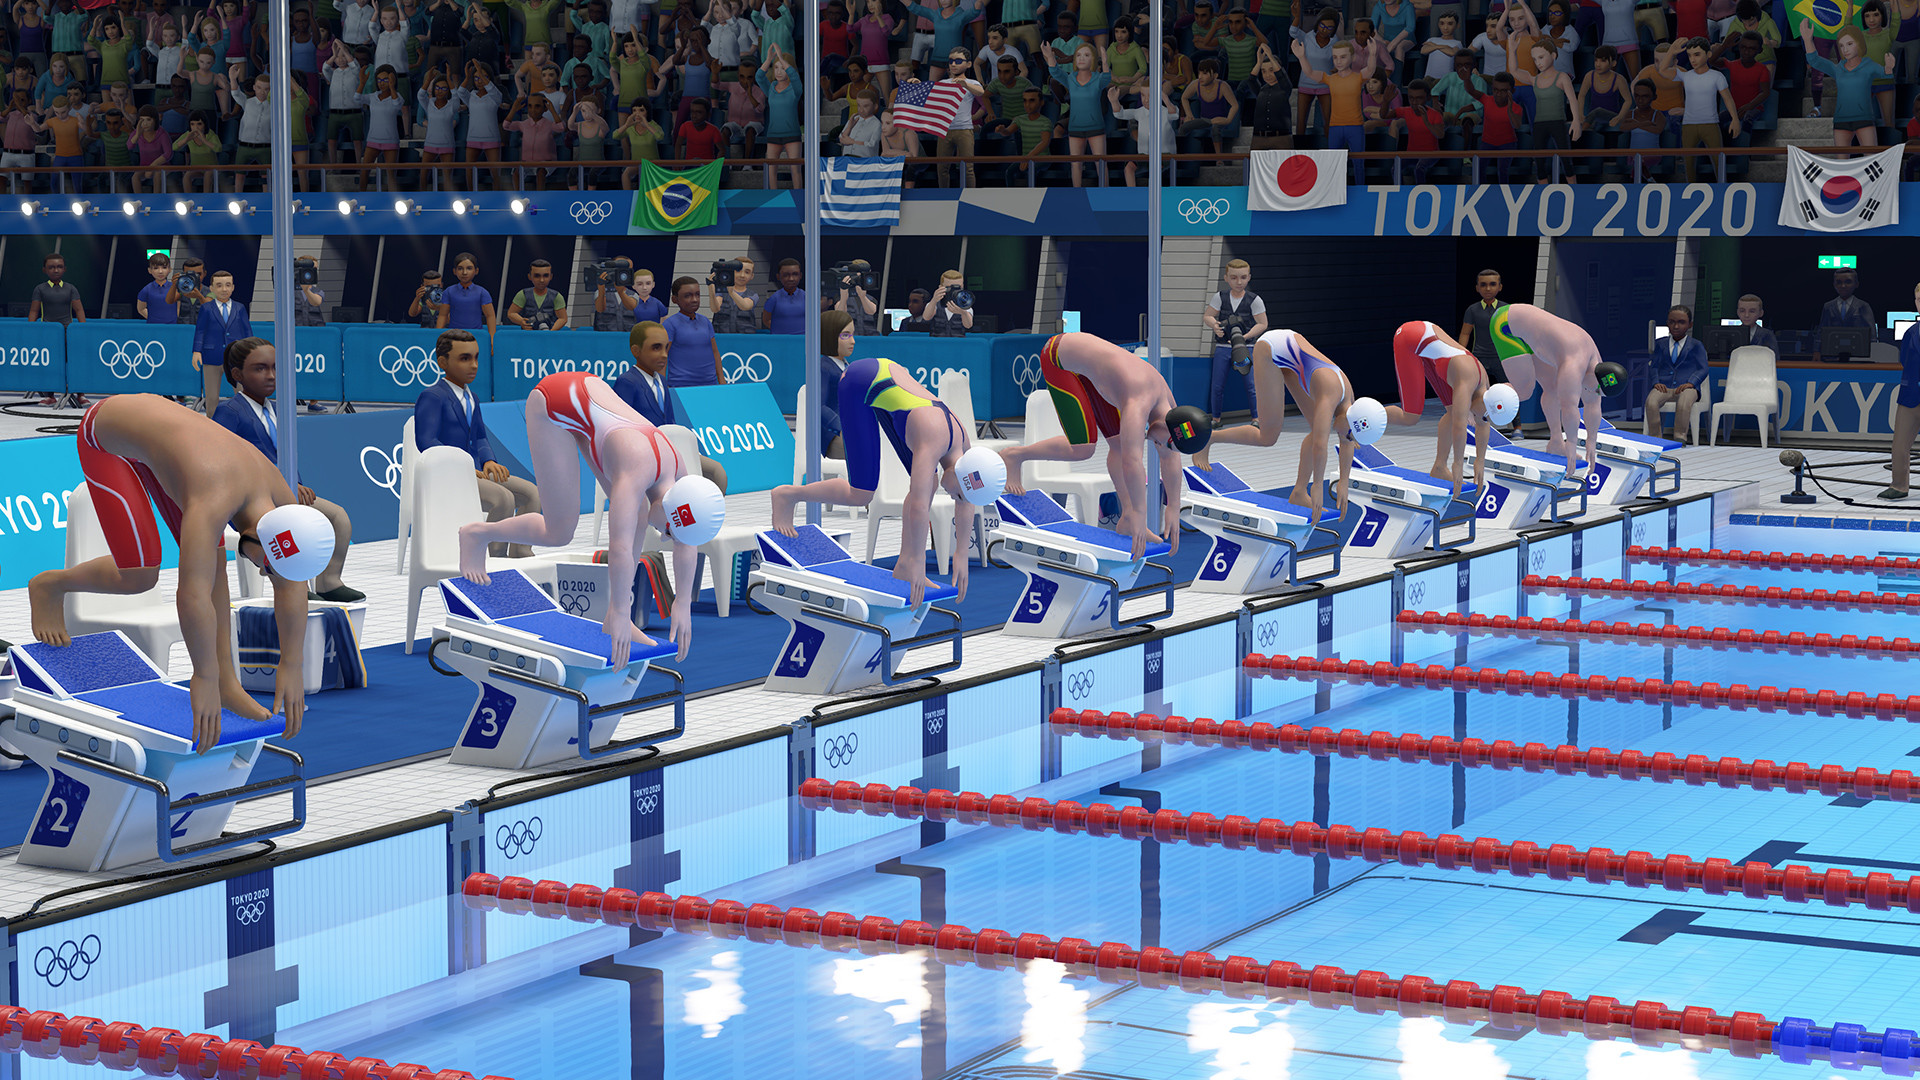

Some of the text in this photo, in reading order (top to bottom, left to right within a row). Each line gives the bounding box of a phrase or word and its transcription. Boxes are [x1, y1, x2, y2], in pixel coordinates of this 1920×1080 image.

[1367, 182, 1757, 237] TOKYO 2020
[9, 346, 50, 367] 2020
[294, 353, 326, 374] 020
[510, 358, 630, 381] TOKYO 2020
[721, 421, 775, 453] 2020
[962, 475, 972, 491] USA
[1588, 472, 1601, 490] 9
[1485, 494, 1498, 513] 8
[1529, 494, 1546, 518] 8
[670, 509, 682, 528] TUR
[983, 517, 1000, 528] 020
[1365, 521, 1379, 540] 7
[1411, 518, 1433, 546] 7
[268, 537, 284, 560] TUN
[1213, 552, 1227, 573] 6
[1269, 550, 1290, 579] 6
[570, 580, 596, 593] 2020
[1028, 591, 1043, 615] 5
[1090, 589, 1111, 621] 5
[789, 641, 807, 668] 4
[863, 646, 883, 674] 4
[480, 706, 499, 737] 3
[633, 787, 649, 799] TOKYO
[50, 796, 70, 833] 2
[231, 887, 270, 906] TOKYO 2020
